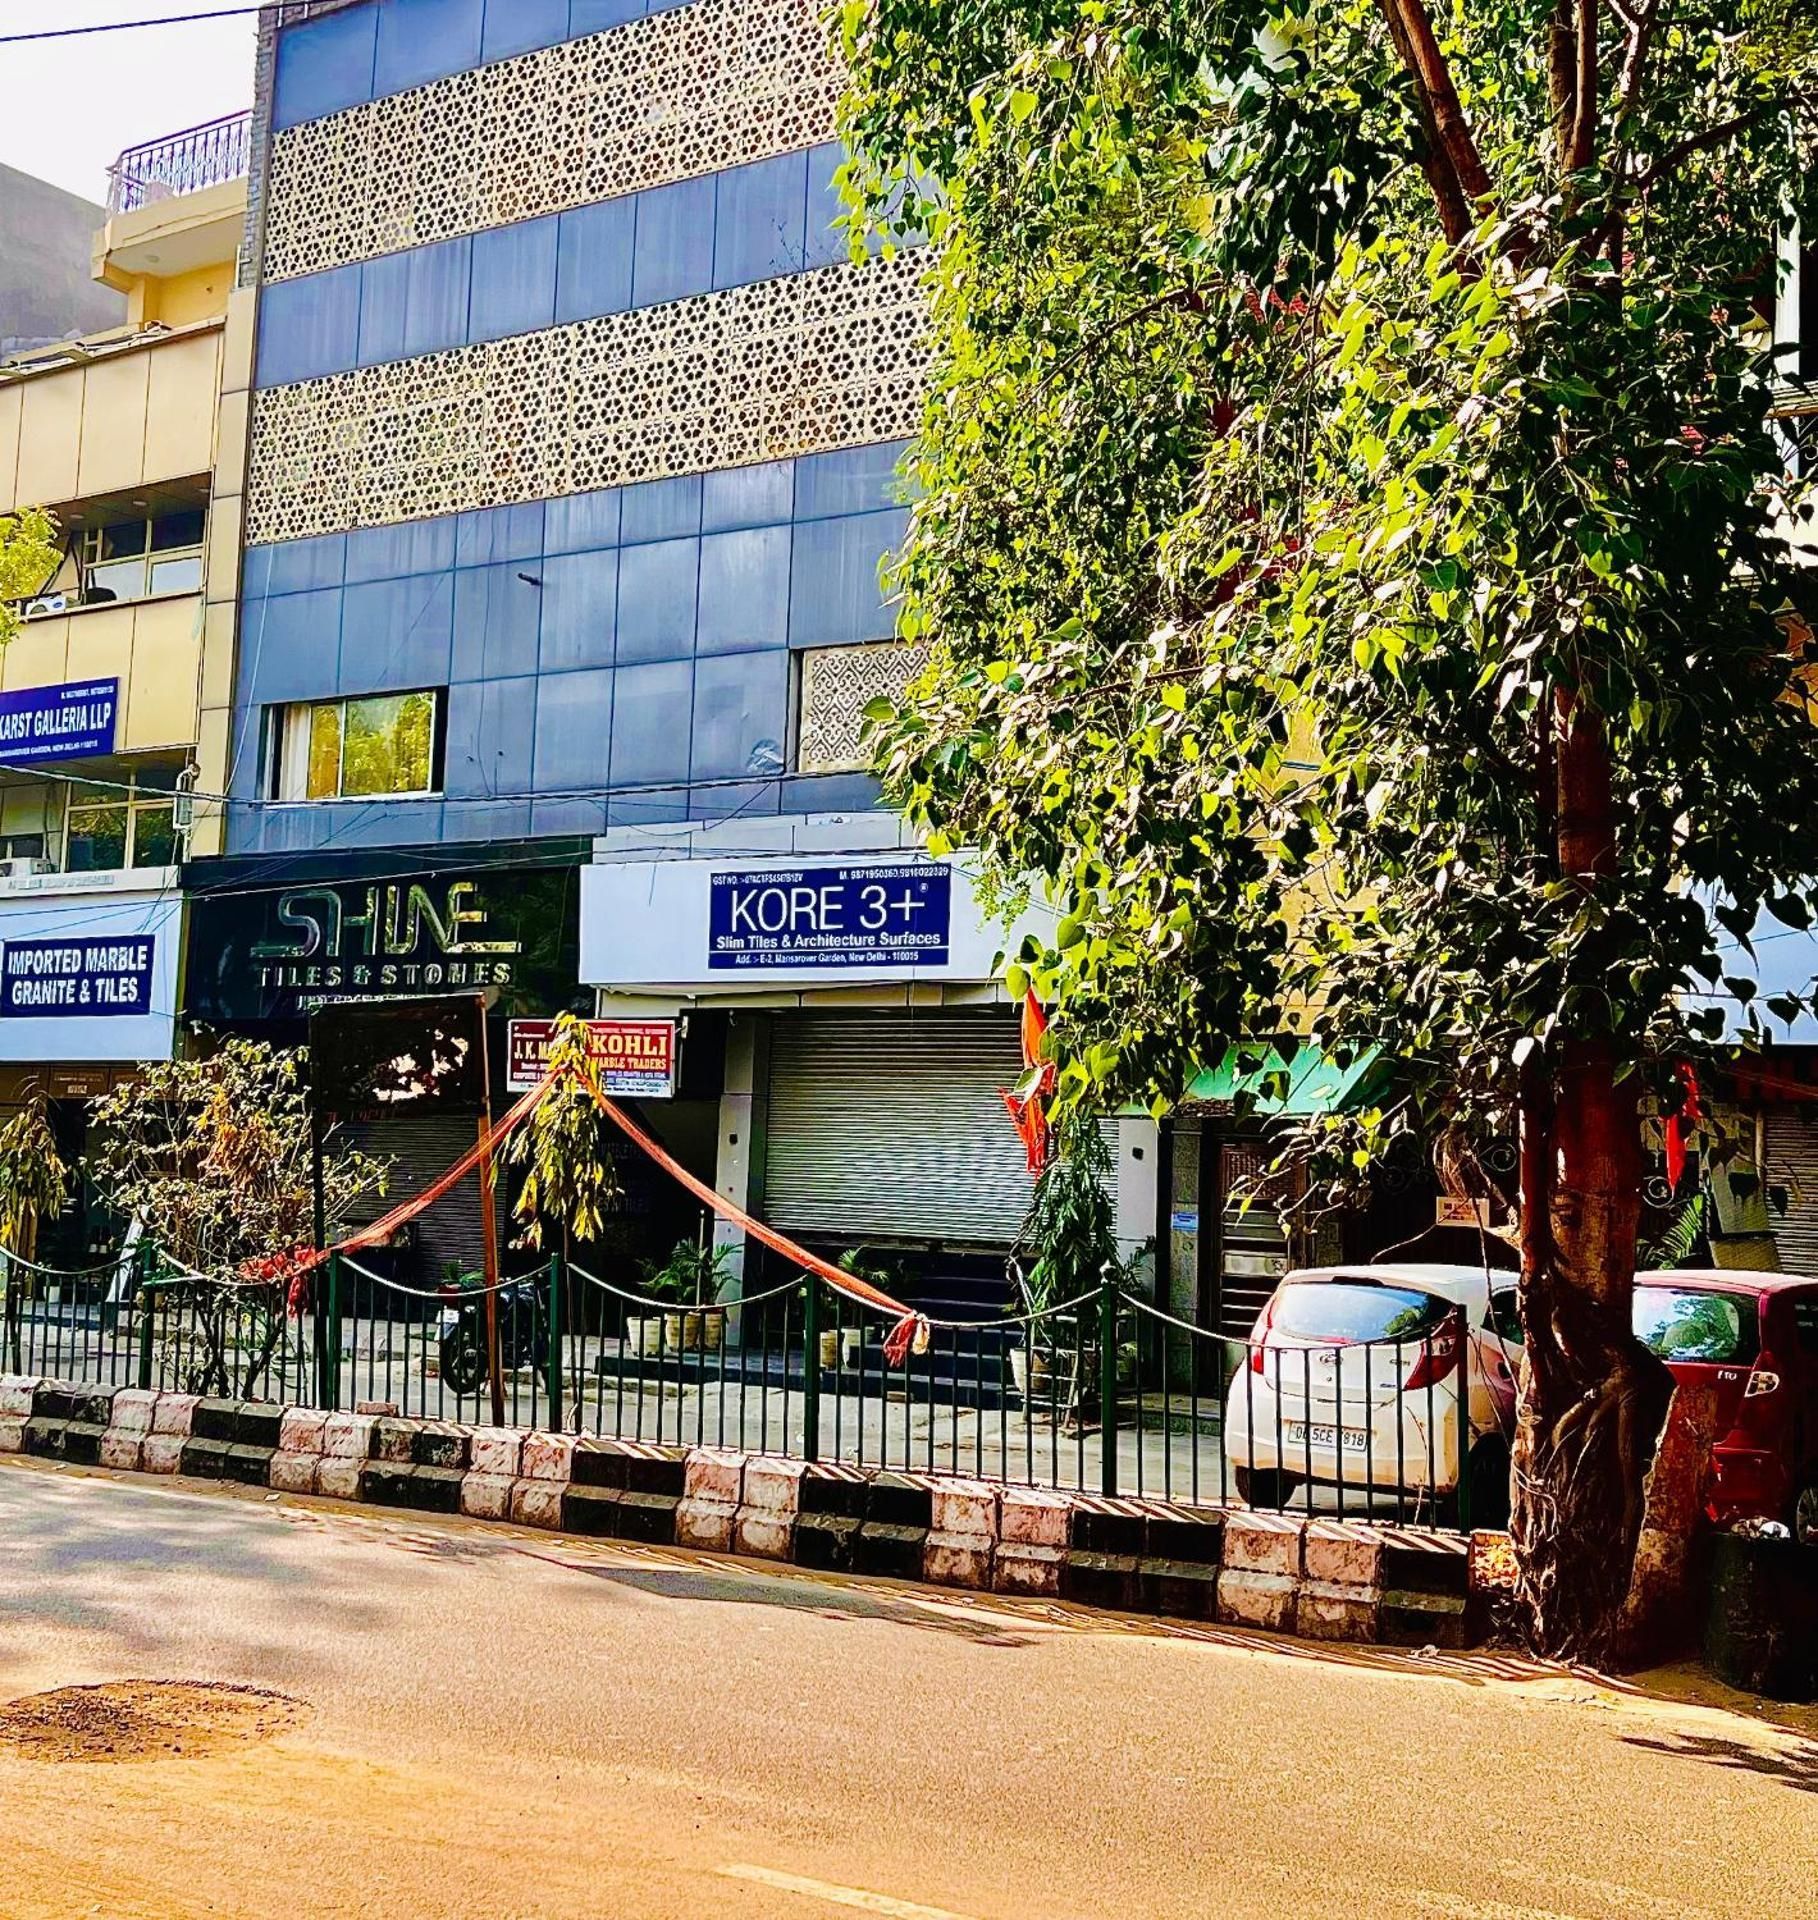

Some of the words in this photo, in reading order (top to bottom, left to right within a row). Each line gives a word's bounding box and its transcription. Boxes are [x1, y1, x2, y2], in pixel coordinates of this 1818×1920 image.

[34, 705, 87, 737] GALLERIA
[90, 702, 112, 730] LLP
[249, 881, 522, 958] SHINE
[731, 886, 845, 932] KORE
[716, 935, 744, 950] Slim
[747, 934, 778, 949] Tiles
[781, 933, 791, 948] &
[793, 932, 876, 949] Architecture
[879, 930, 941, 946] Surfaces
[8, 949, 81, 975] IMPORTED
[85, 945, 148, 973] MARBLE
[848, 952, 865, 962] New
[866, 951, 886, 962] Delhi
[892, 951, 919, 961] 110015
[258, 965, 343, 988] TILES
[353, 965, 371, 985] &
[380, 962, 512, 986] STONES
[12, 979, 76, 1005] GRANITE
[79, 980, 91, 1004] &
[95, 976, 138, 1003] TILES
[591, 1034, 667, 1056] KOHLI
[627, 1057, 667, 1070] TRADERS
